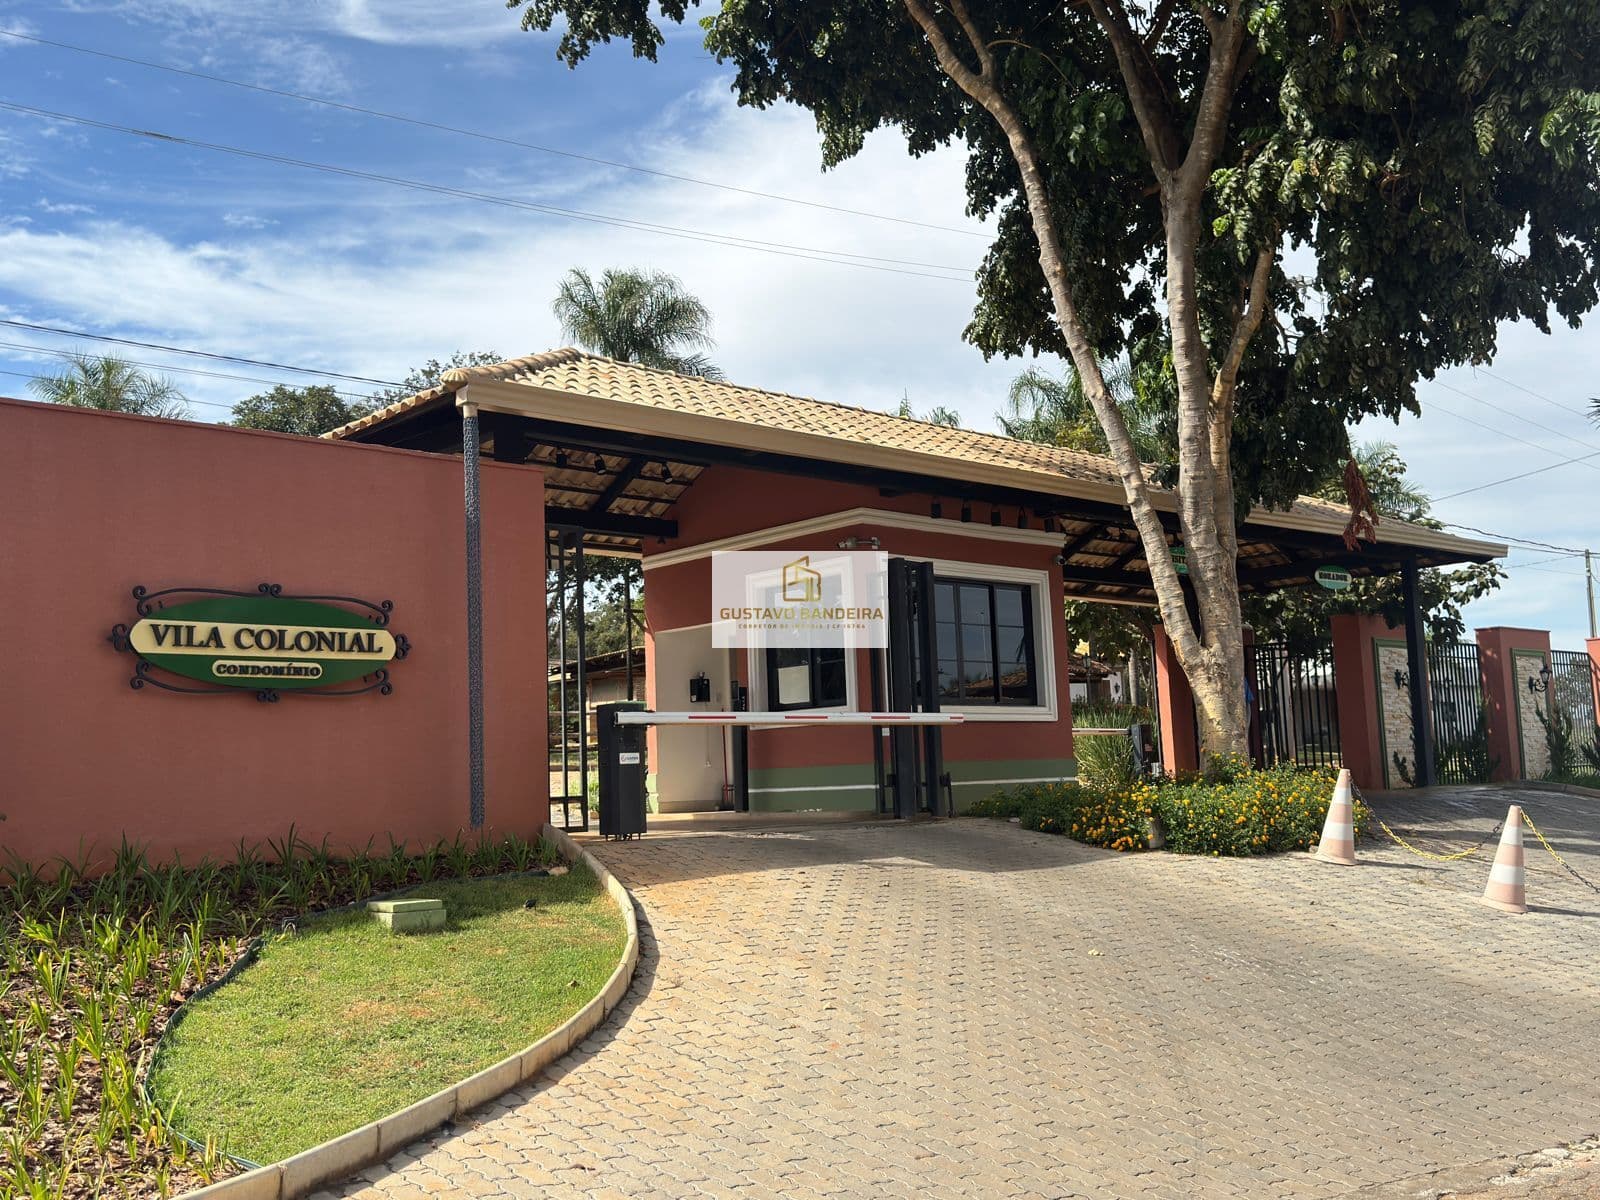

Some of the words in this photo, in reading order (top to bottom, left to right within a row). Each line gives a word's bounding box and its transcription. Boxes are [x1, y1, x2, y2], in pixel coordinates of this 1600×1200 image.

[150, 623, 225, 649] VILA
[234, 627, 383, 654] COLONIAL
[216, 663, 322, 678] CONDOMÍNIO
